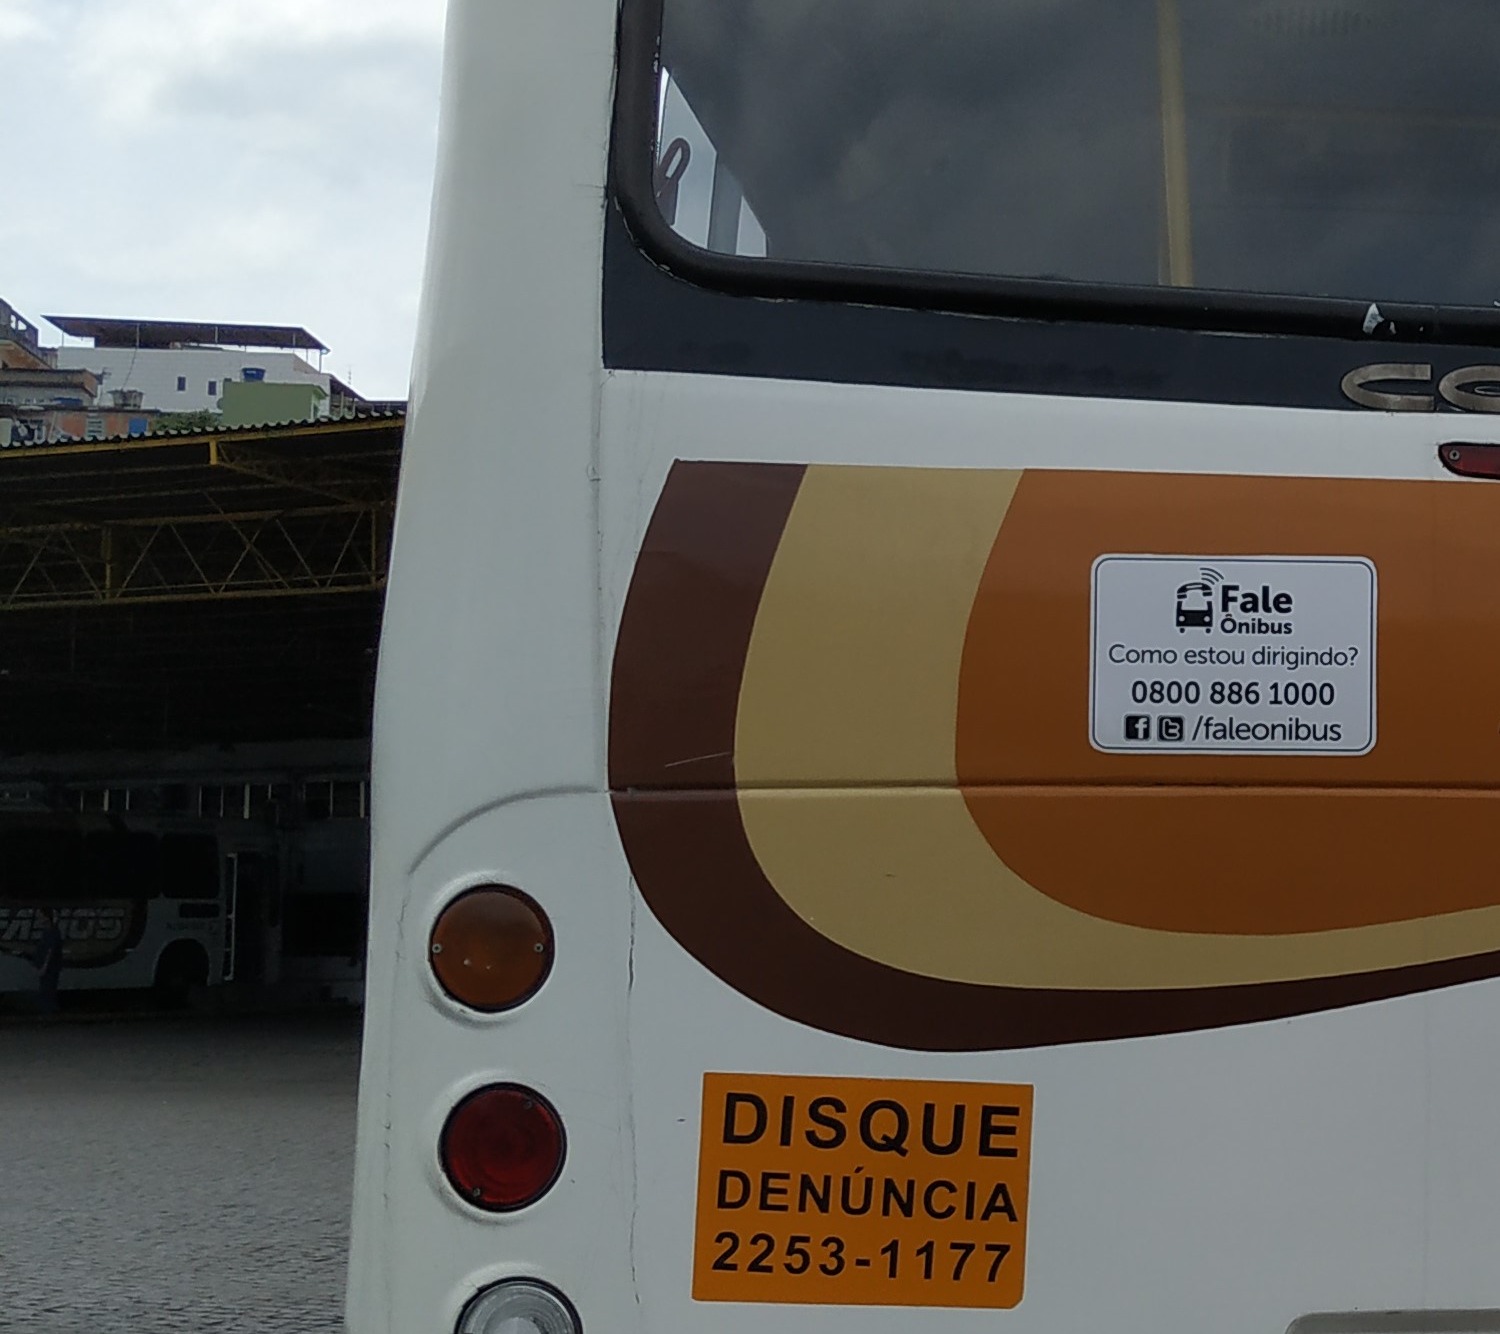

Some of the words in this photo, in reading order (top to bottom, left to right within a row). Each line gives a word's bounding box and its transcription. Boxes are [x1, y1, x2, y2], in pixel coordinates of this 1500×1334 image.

[1220, 584, 1293, 614] Fale
[1220, 613, 1293, 635] Ônibus
[1108, 643, 1177, 664] Como
[1184, 647, 1245, 665] estou
[1252, 646, 1358, 670] dirigindo?
[1131, 681, 1200, 704] 0800
[1209, 681, 1260, 705] 886
[1268, 682, 1335, 706] 1000
[1191, 716, 1342, 742] /faleonibus
[722, 1092, 1021, 1158] DISQUE
[716, 1166, 1019, 1222] DENÚNCIA
[711, 1231, 1011, 1283] 2253-1177
